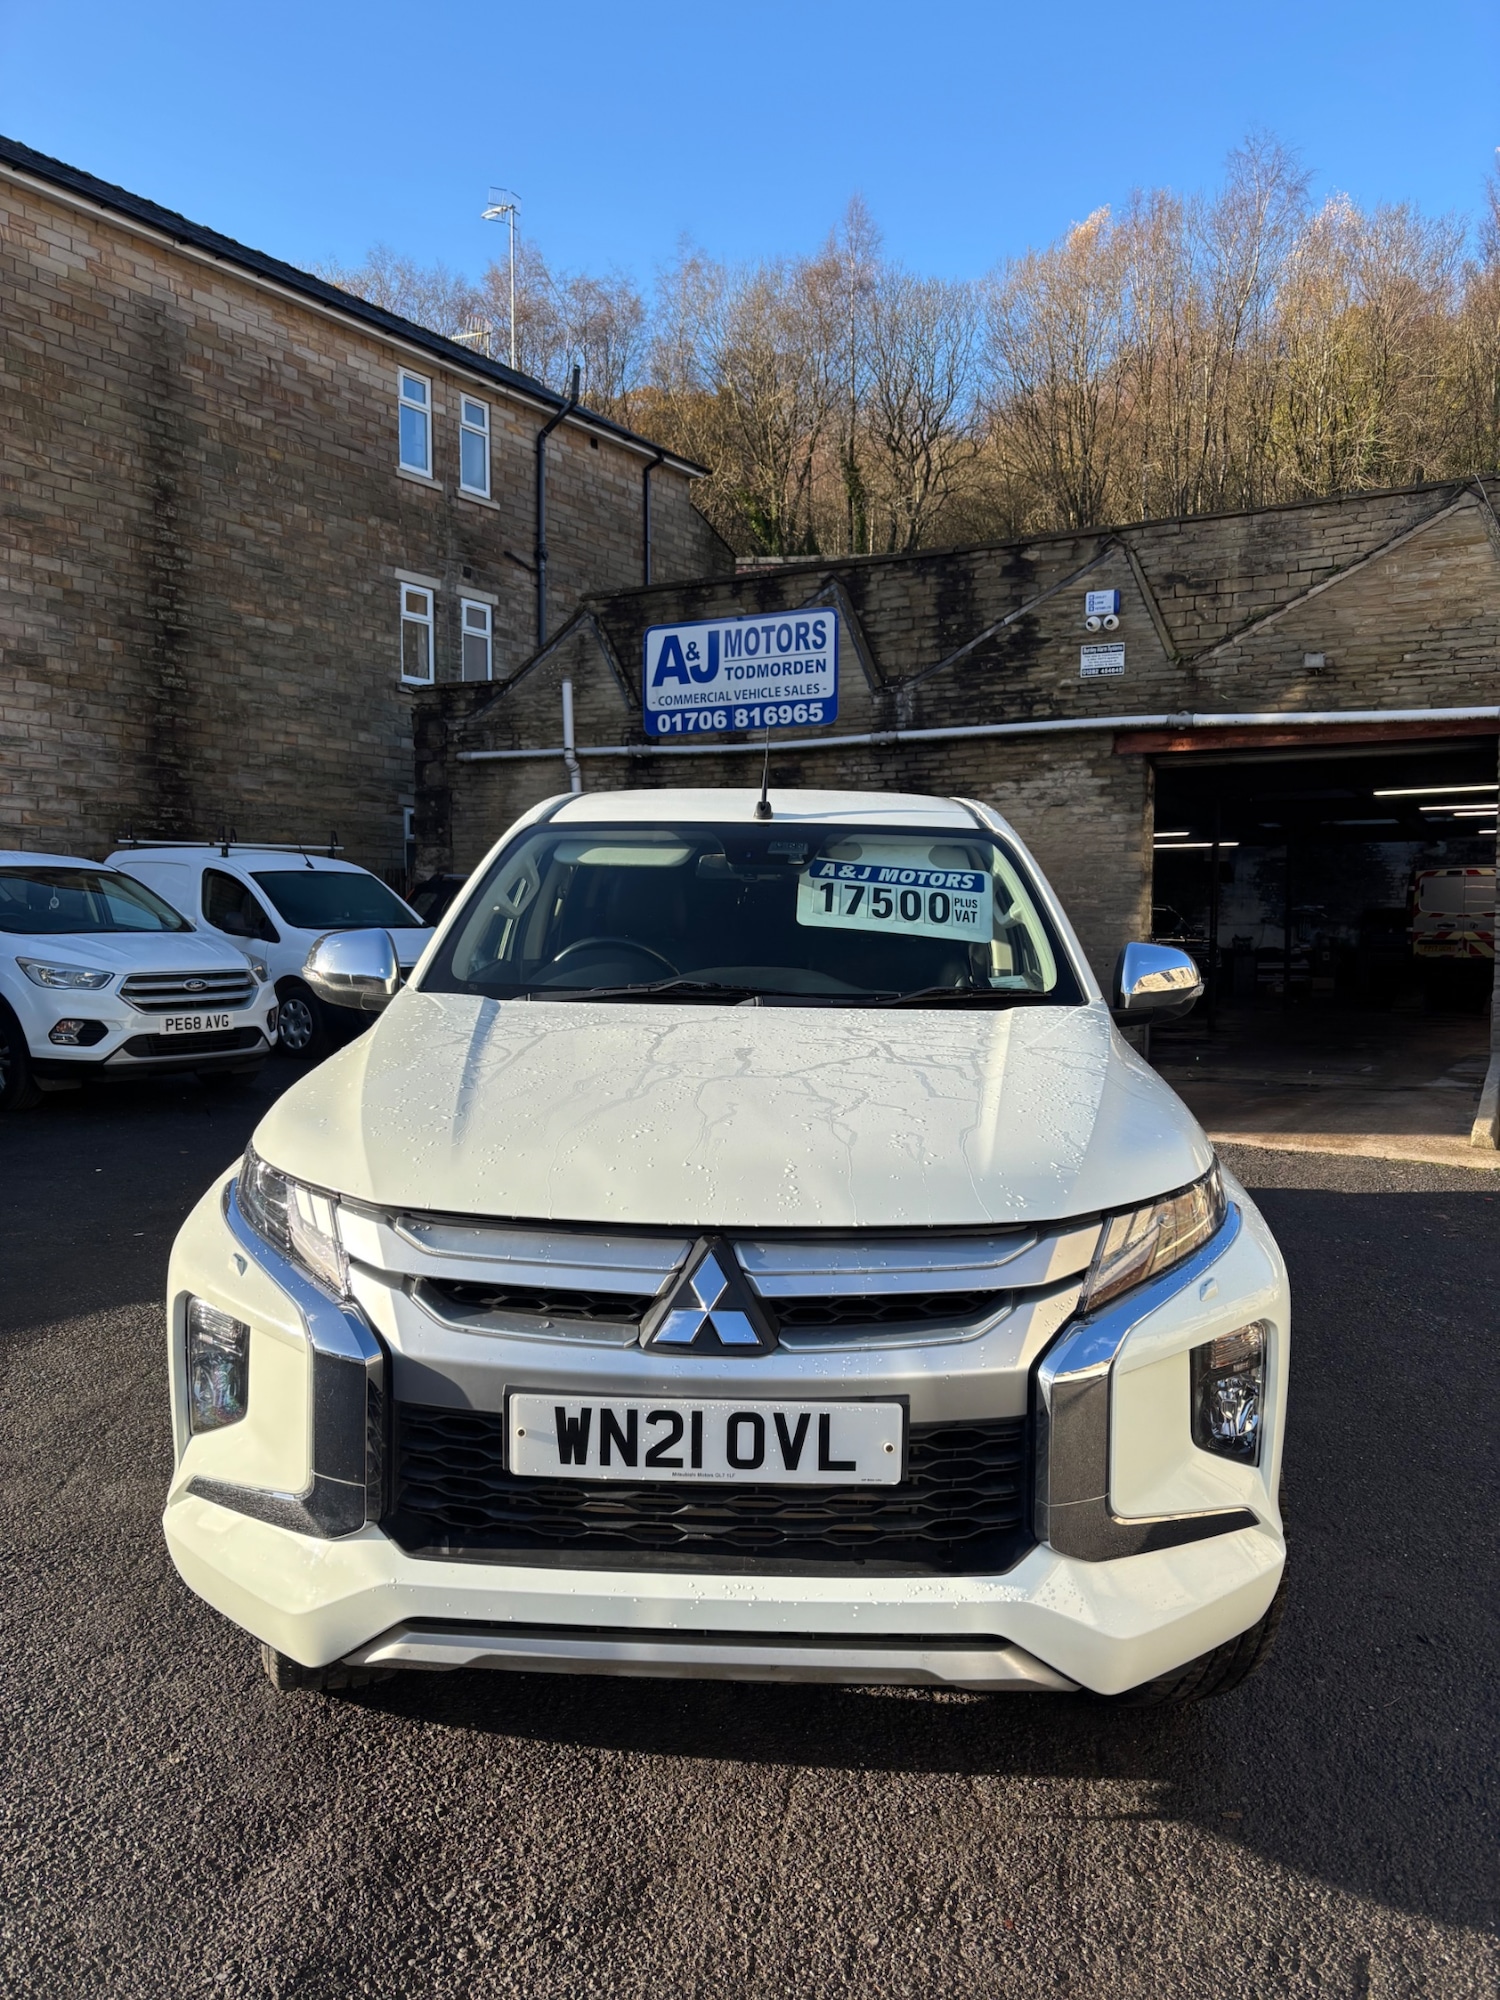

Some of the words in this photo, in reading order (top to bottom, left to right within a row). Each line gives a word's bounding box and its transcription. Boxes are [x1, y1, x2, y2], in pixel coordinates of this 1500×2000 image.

[652, 630, 720, 687] A&J
[724, 620, 826, 658] MOTORS
[724, 658, 826, 680] TODMORDEN
[658, 690, 731, 706] COMMERCIAL
[734, 686, 781, 700] VEHICLE
[784, 684, 819, 696] SALES
[657, 710, 727, 732] 01706
[734, 702, 824, 728] 816965
[819, 863, 871, 879] A&J
[878, 869, 975, 889] MOTORS
[820, 882, 950, 923] 17500
[954, 897, 978, 908] PLUS
[955, 910, 978, 923] VAT
[166, 1017, 201, 1031] PE68
[206, 1015, 228, 1029] AVG
[555, 1407, 702, 1468] WN21
[726, 1412, 856, 1471] OVL
